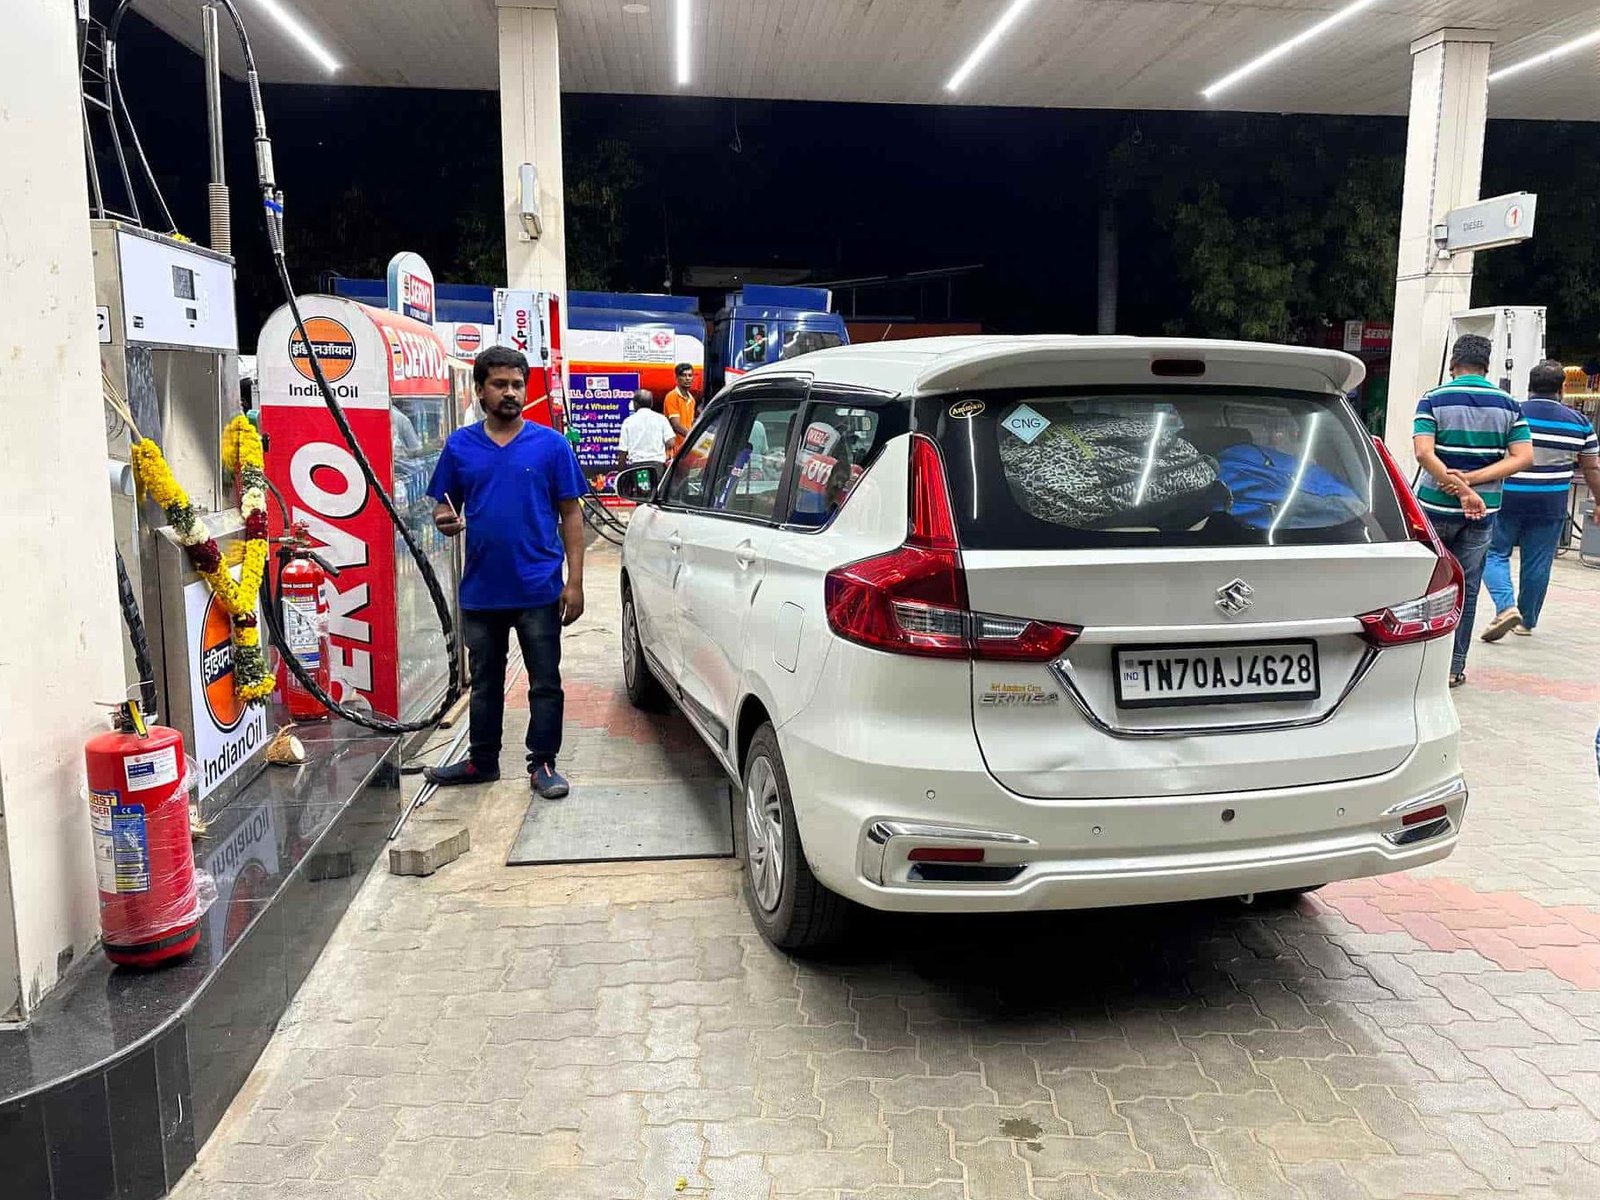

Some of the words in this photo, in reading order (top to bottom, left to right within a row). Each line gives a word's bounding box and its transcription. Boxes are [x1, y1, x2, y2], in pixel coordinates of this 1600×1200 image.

[1511, 208, 1519, 225] 1
[1463, 220, 1485, 231] DIESEL
[410, 277, 431, 310] SERVO
[511, 309, 528, 352] XP100
[1363, 328, 1392, 339] SERV
[291, 342, 352, 357] इंडिनऑयल
[1011, 418, 1041, 429] CNG
[203, 647, 234, 684] इंडियन
[1138, 653, 1312, 692] TN70AJ4628
[1123, 672, 1139, 682] IND
[204, 715, 263, 788] IndianOil
